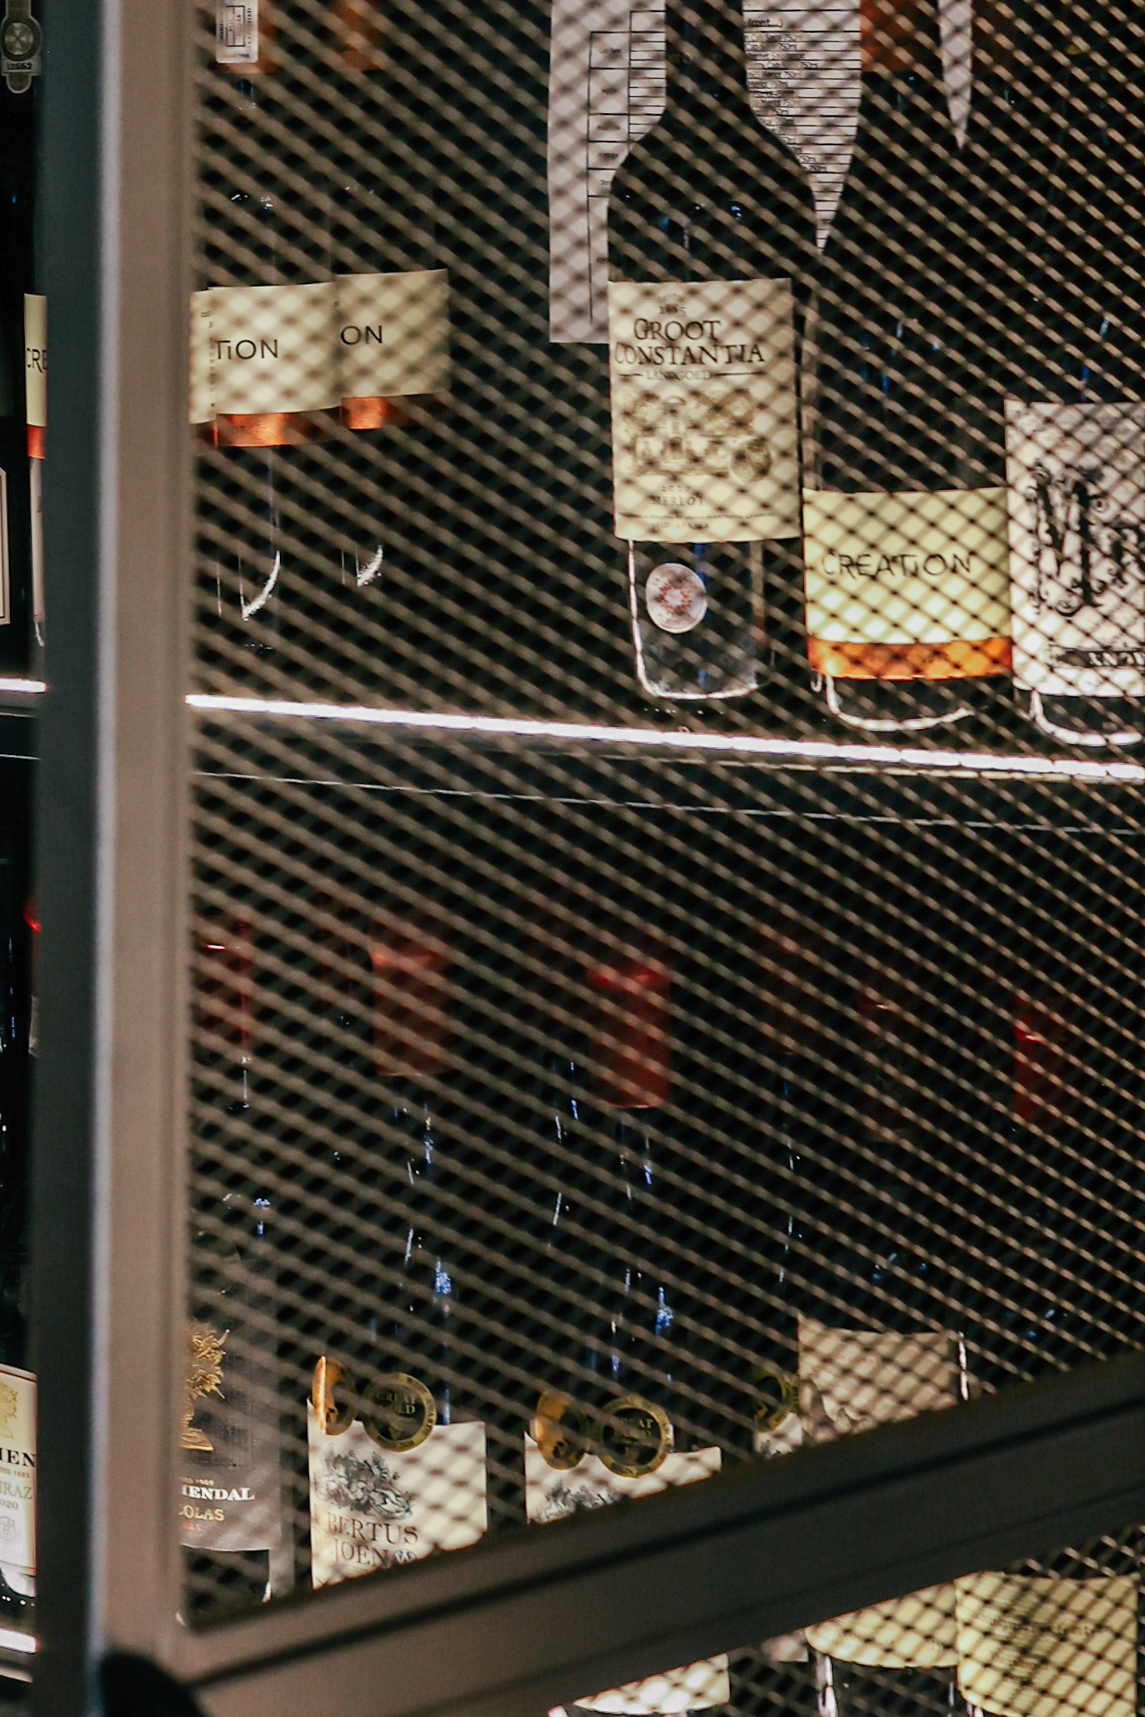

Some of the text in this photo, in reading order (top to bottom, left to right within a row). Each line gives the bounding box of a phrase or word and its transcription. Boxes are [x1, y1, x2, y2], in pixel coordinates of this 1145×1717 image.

[340, 324, 383, 346] ON
[634, 317, 722, 342] GROOT
[614, 341, 766, 366] CONSTANTIA
[179, 1504, 226, 1522] OLAS
[313, 1505, 419, 1545] BERTUS
[322, 1531, 389, 1568] JOEN
